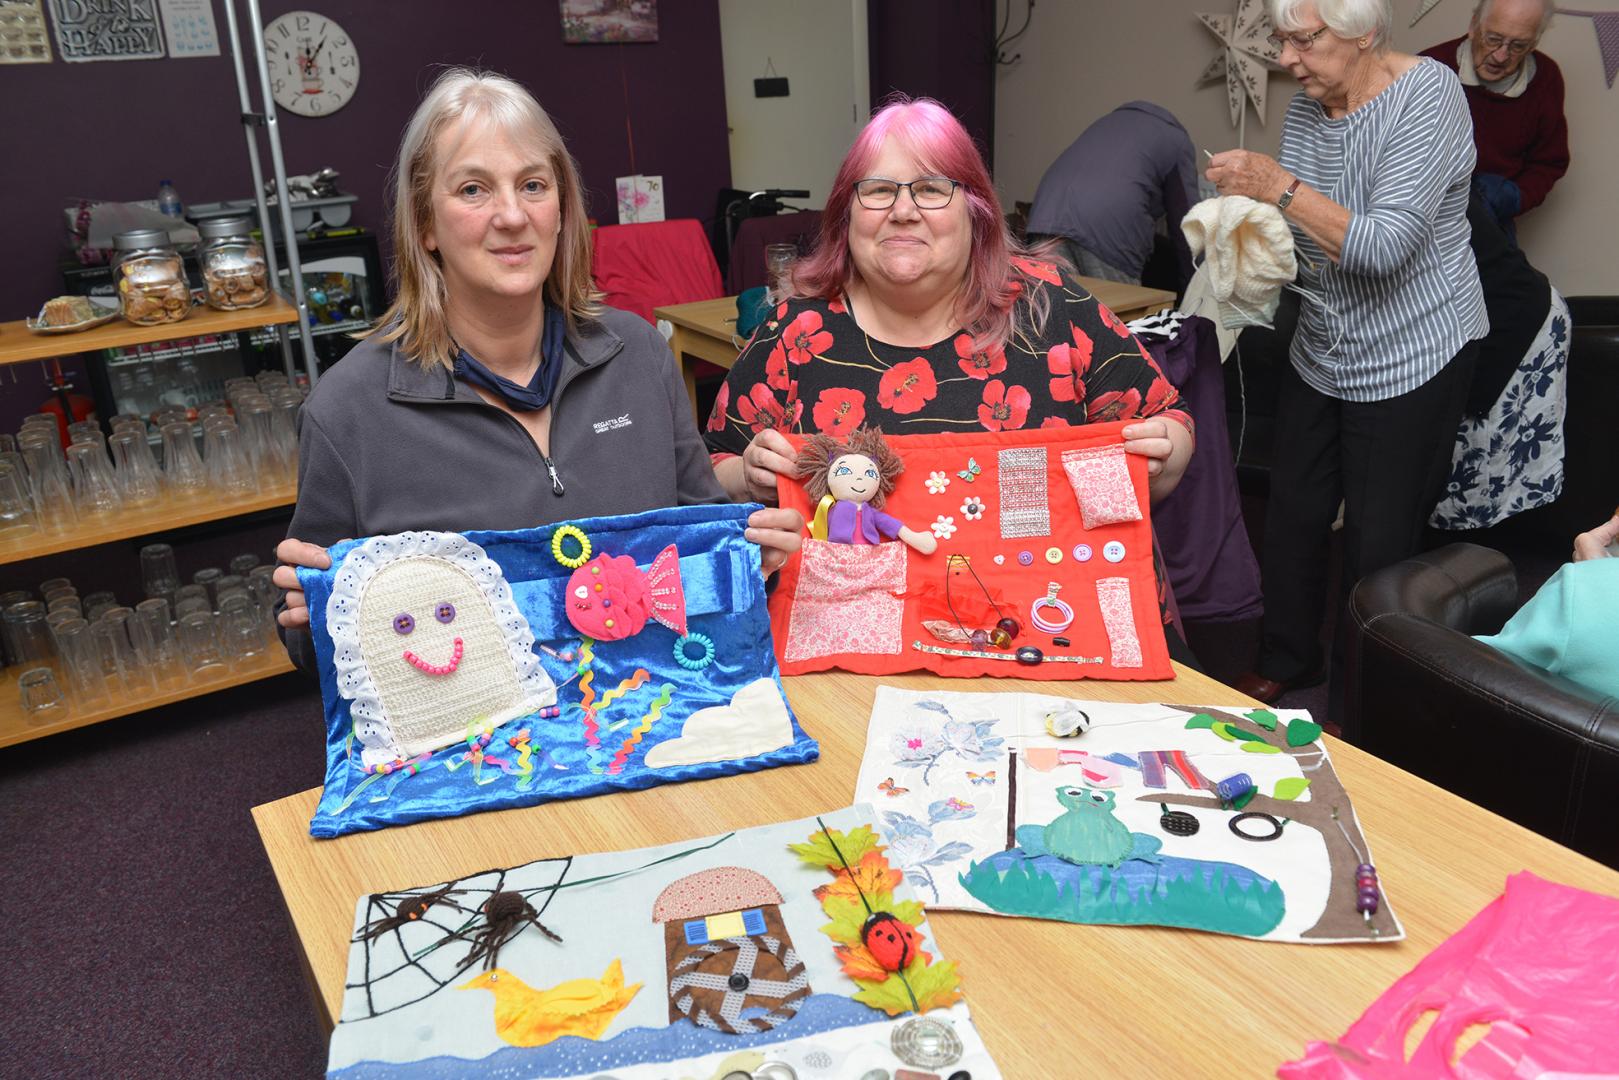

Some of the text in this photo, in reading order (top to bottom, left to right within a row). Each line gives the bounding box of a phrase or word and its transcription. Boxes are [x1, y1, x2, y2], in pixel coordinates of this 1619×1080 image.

[296, 16, 310, 31] 12
[63, 28, 155, 56] HAPPY
[332, 36, 347, 49] 2
[290, 90, 303, 107] 7
[310, 97, 321, 112] 6
[593, 419, 618, 429] REGATTA
